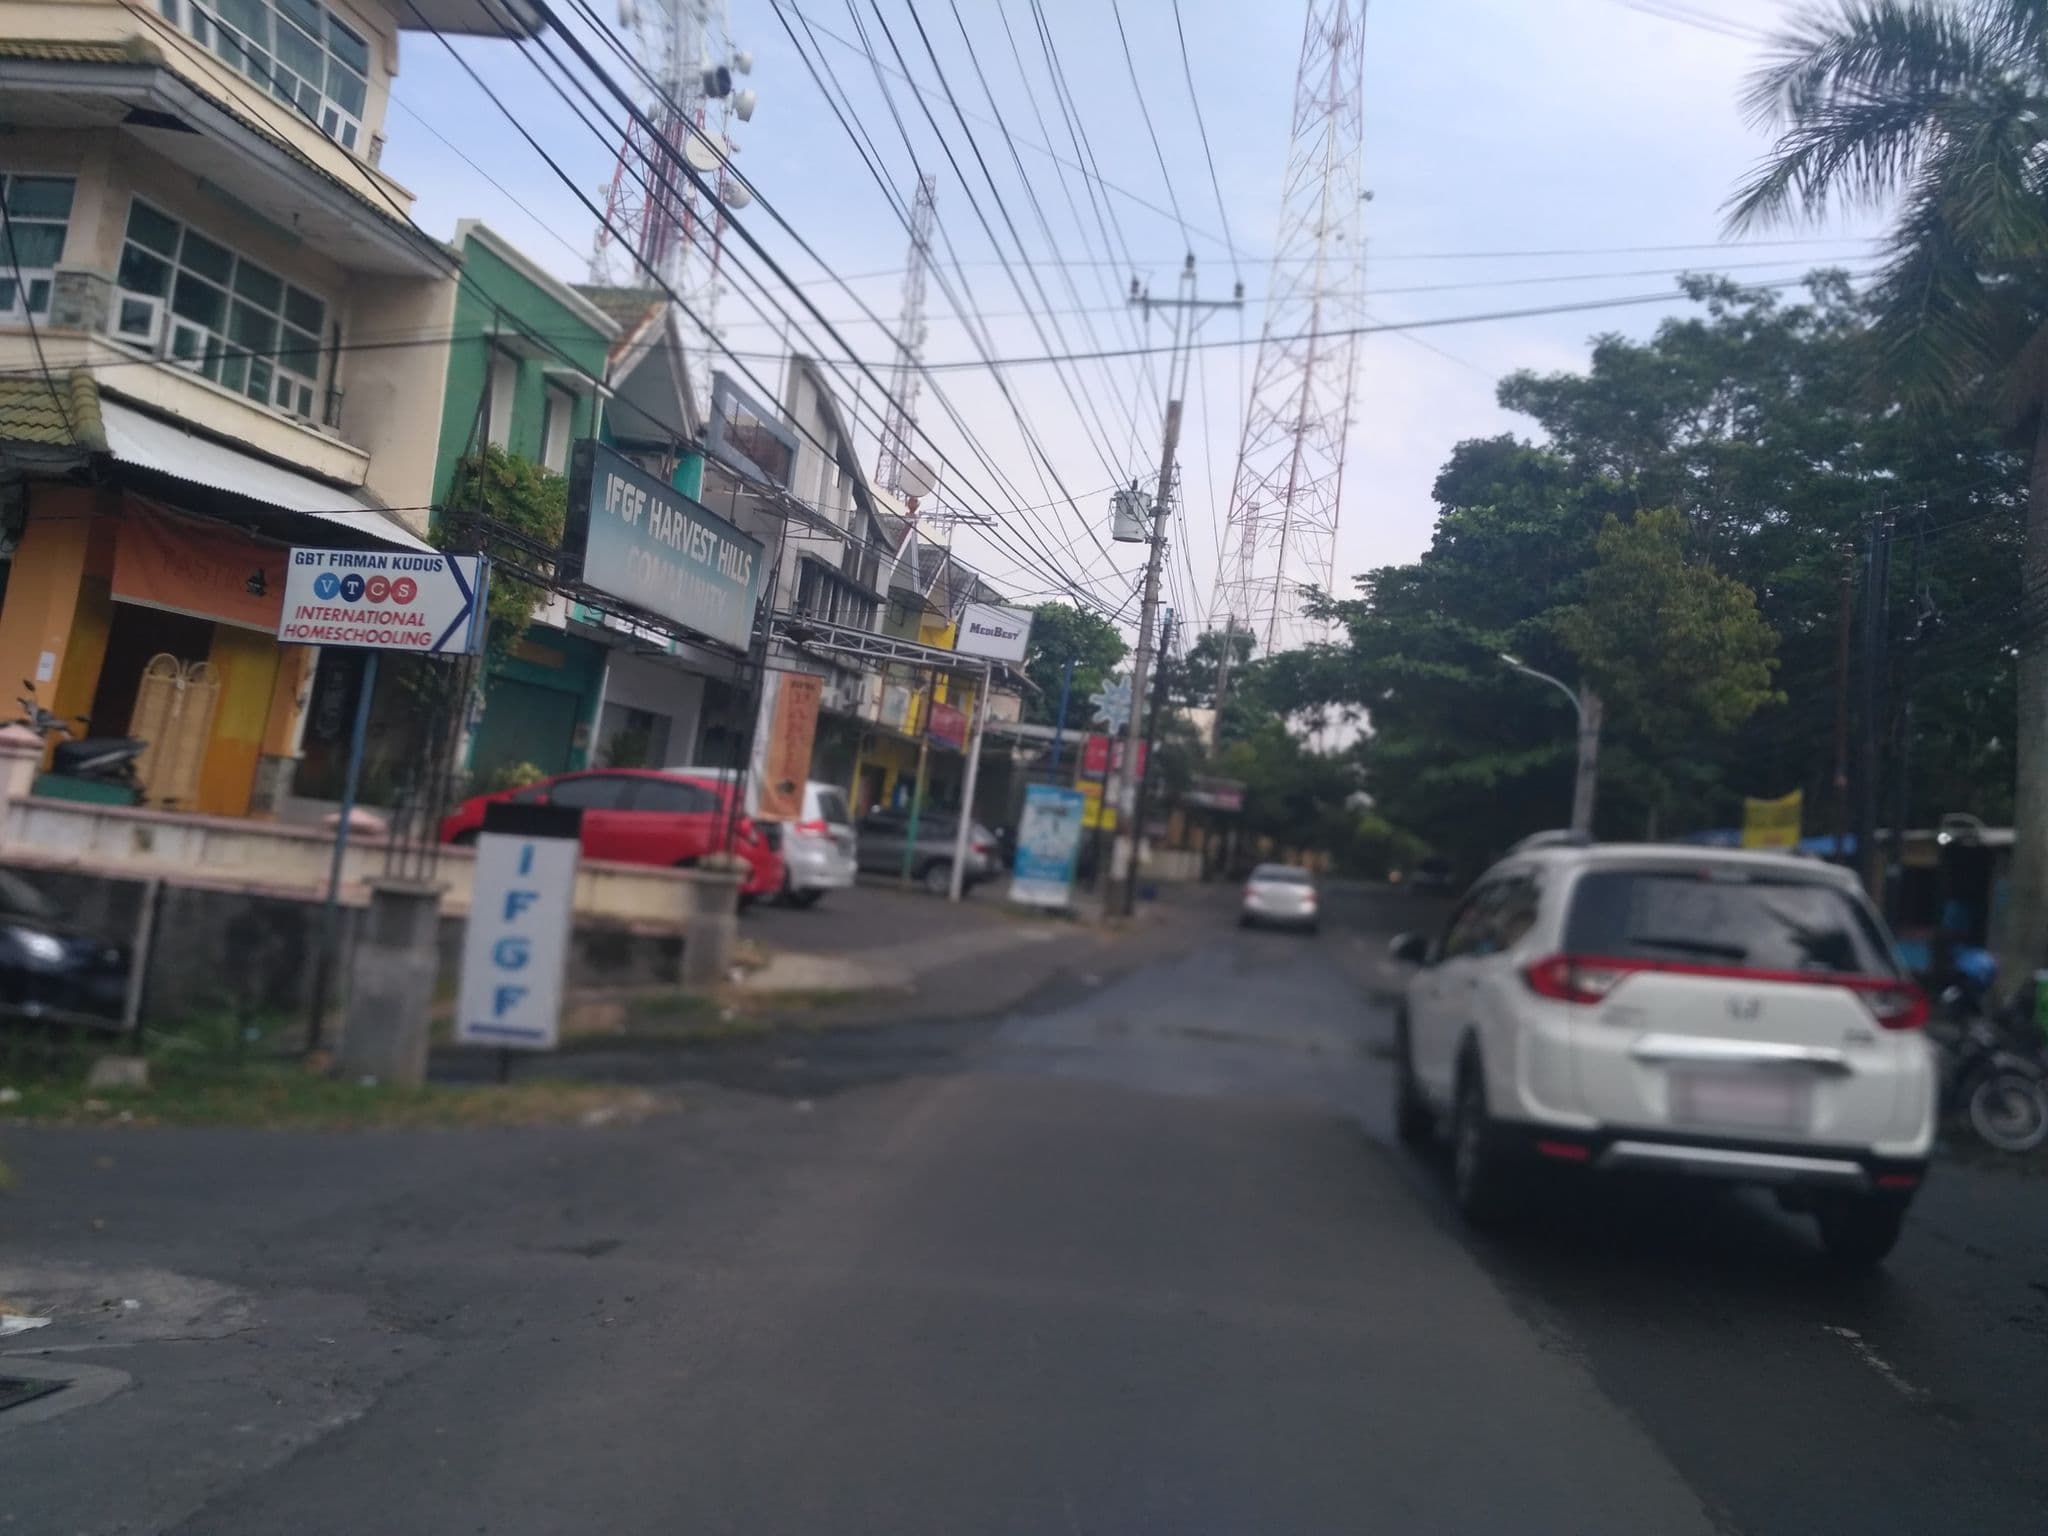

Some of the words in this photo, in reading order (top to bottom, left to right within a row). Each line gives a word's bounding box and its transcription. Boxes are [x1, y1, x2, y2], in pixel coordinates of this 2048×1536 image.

[605, 473, 647, 526] IFGF
[648, 496, 718, 567] HARVEST
[717, 538, 753, 587] HILLS
[295, 551, 325, 566] GBT
[329, 554, 388, 569] FIRMAN
[392, 558, 443, 573] KUDUS
[295, 605, 425, 627] INTERNATIONAL
[284, 624, 432, 646] HOMESCHOOLING
[491, 841, 540, 1019] IFGF
